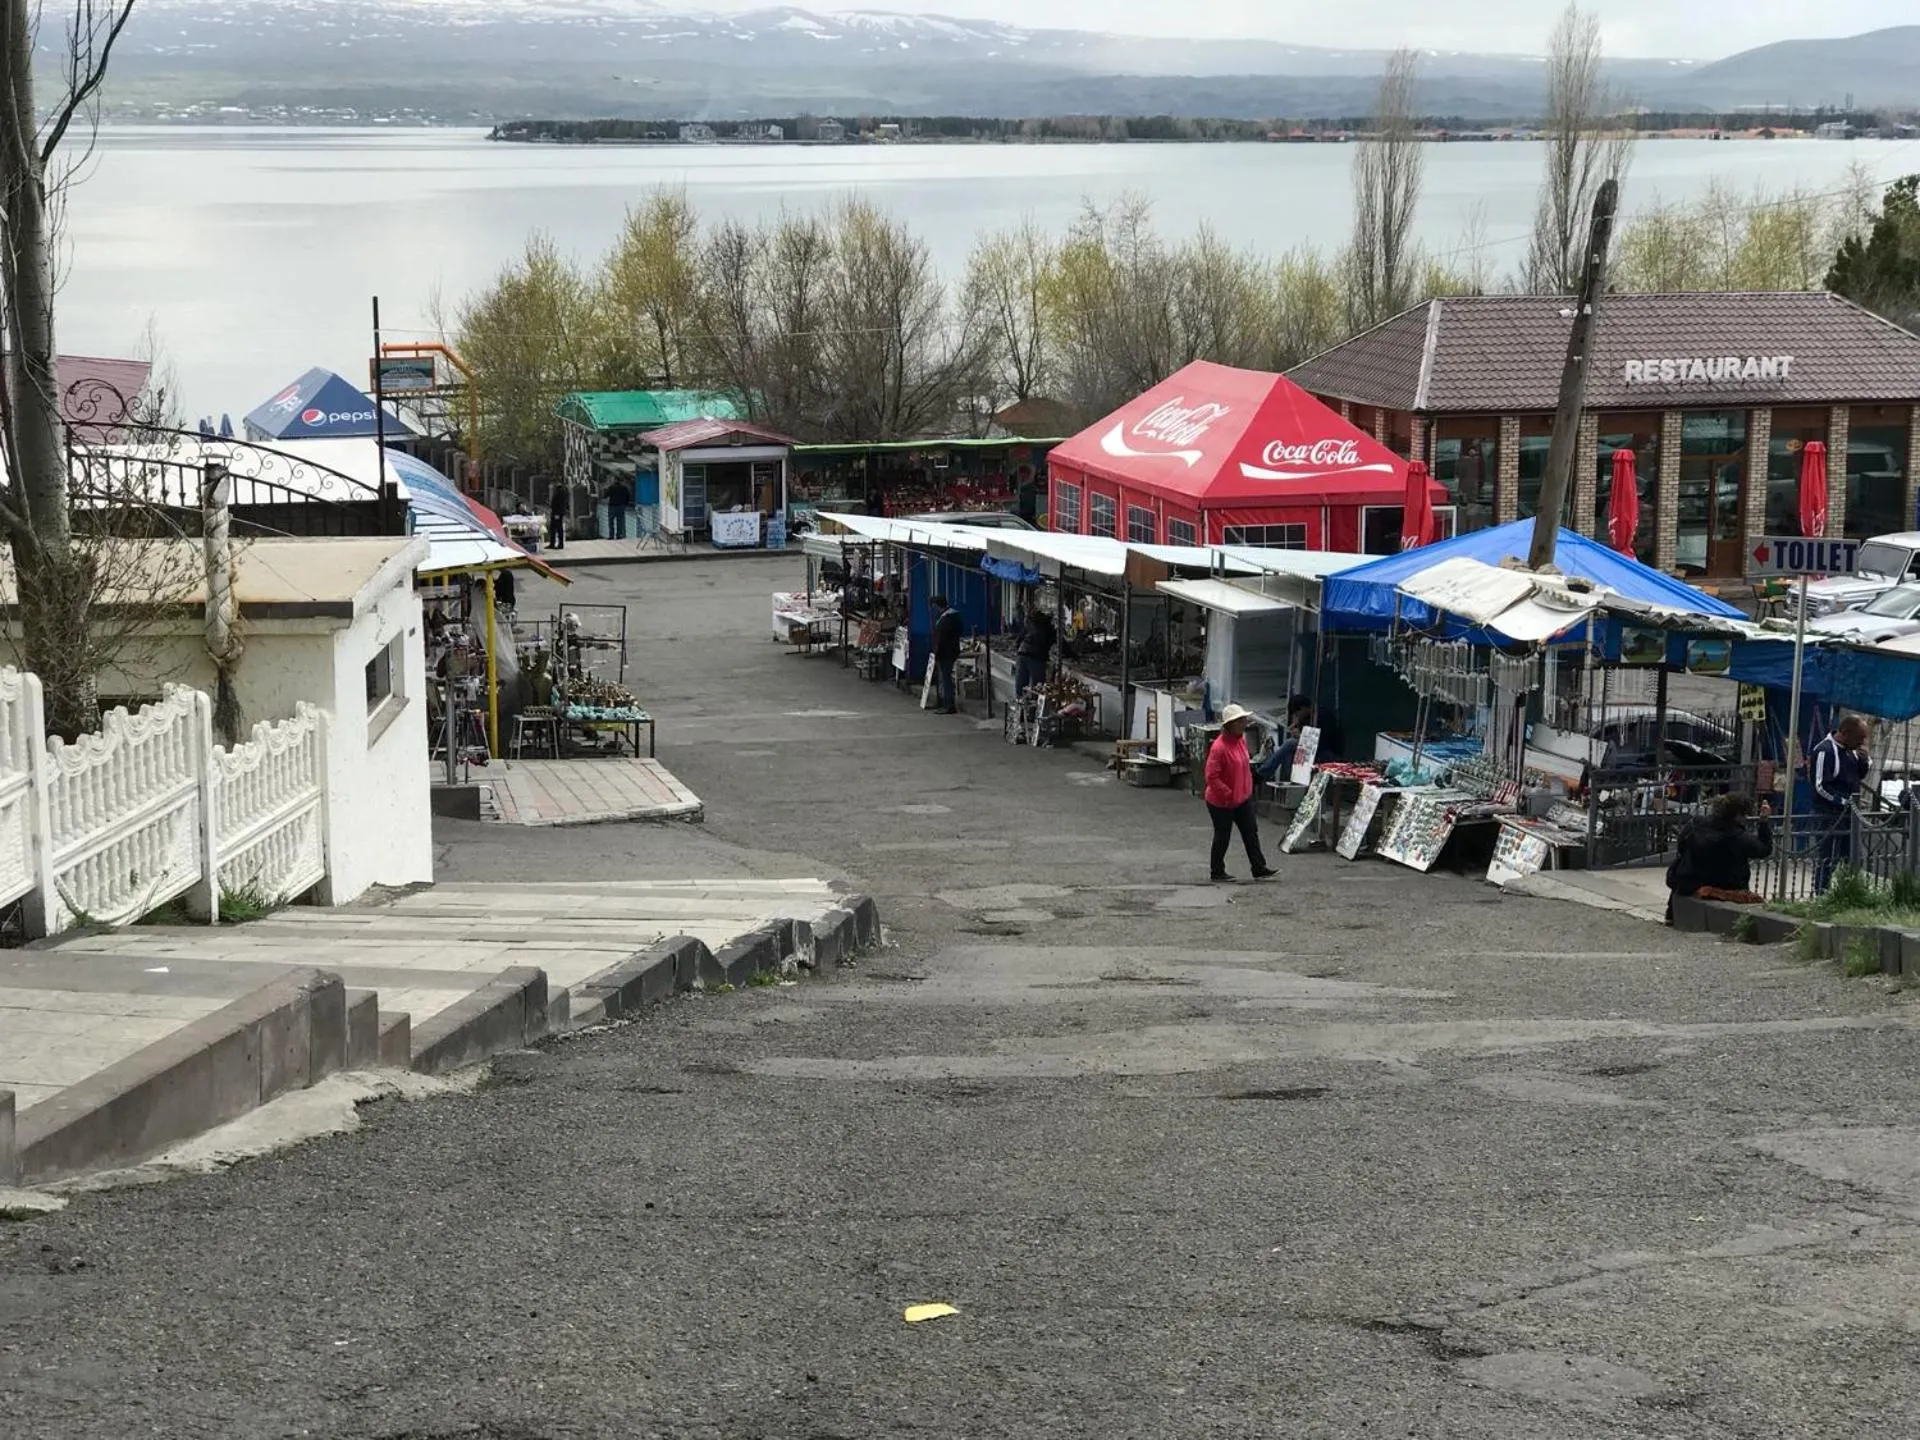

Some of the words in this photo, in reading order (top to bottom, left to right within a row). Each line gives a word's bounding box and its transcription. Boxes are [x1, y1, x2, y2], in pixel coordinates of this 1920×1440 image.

[1625, 355, 1794, 382] RESTAURANT
[329, 408, 378, 425] pepsi
[1262, 438, 1361, 466] Coca-Cola
[1773, 540, 1857, 572] TOILET
